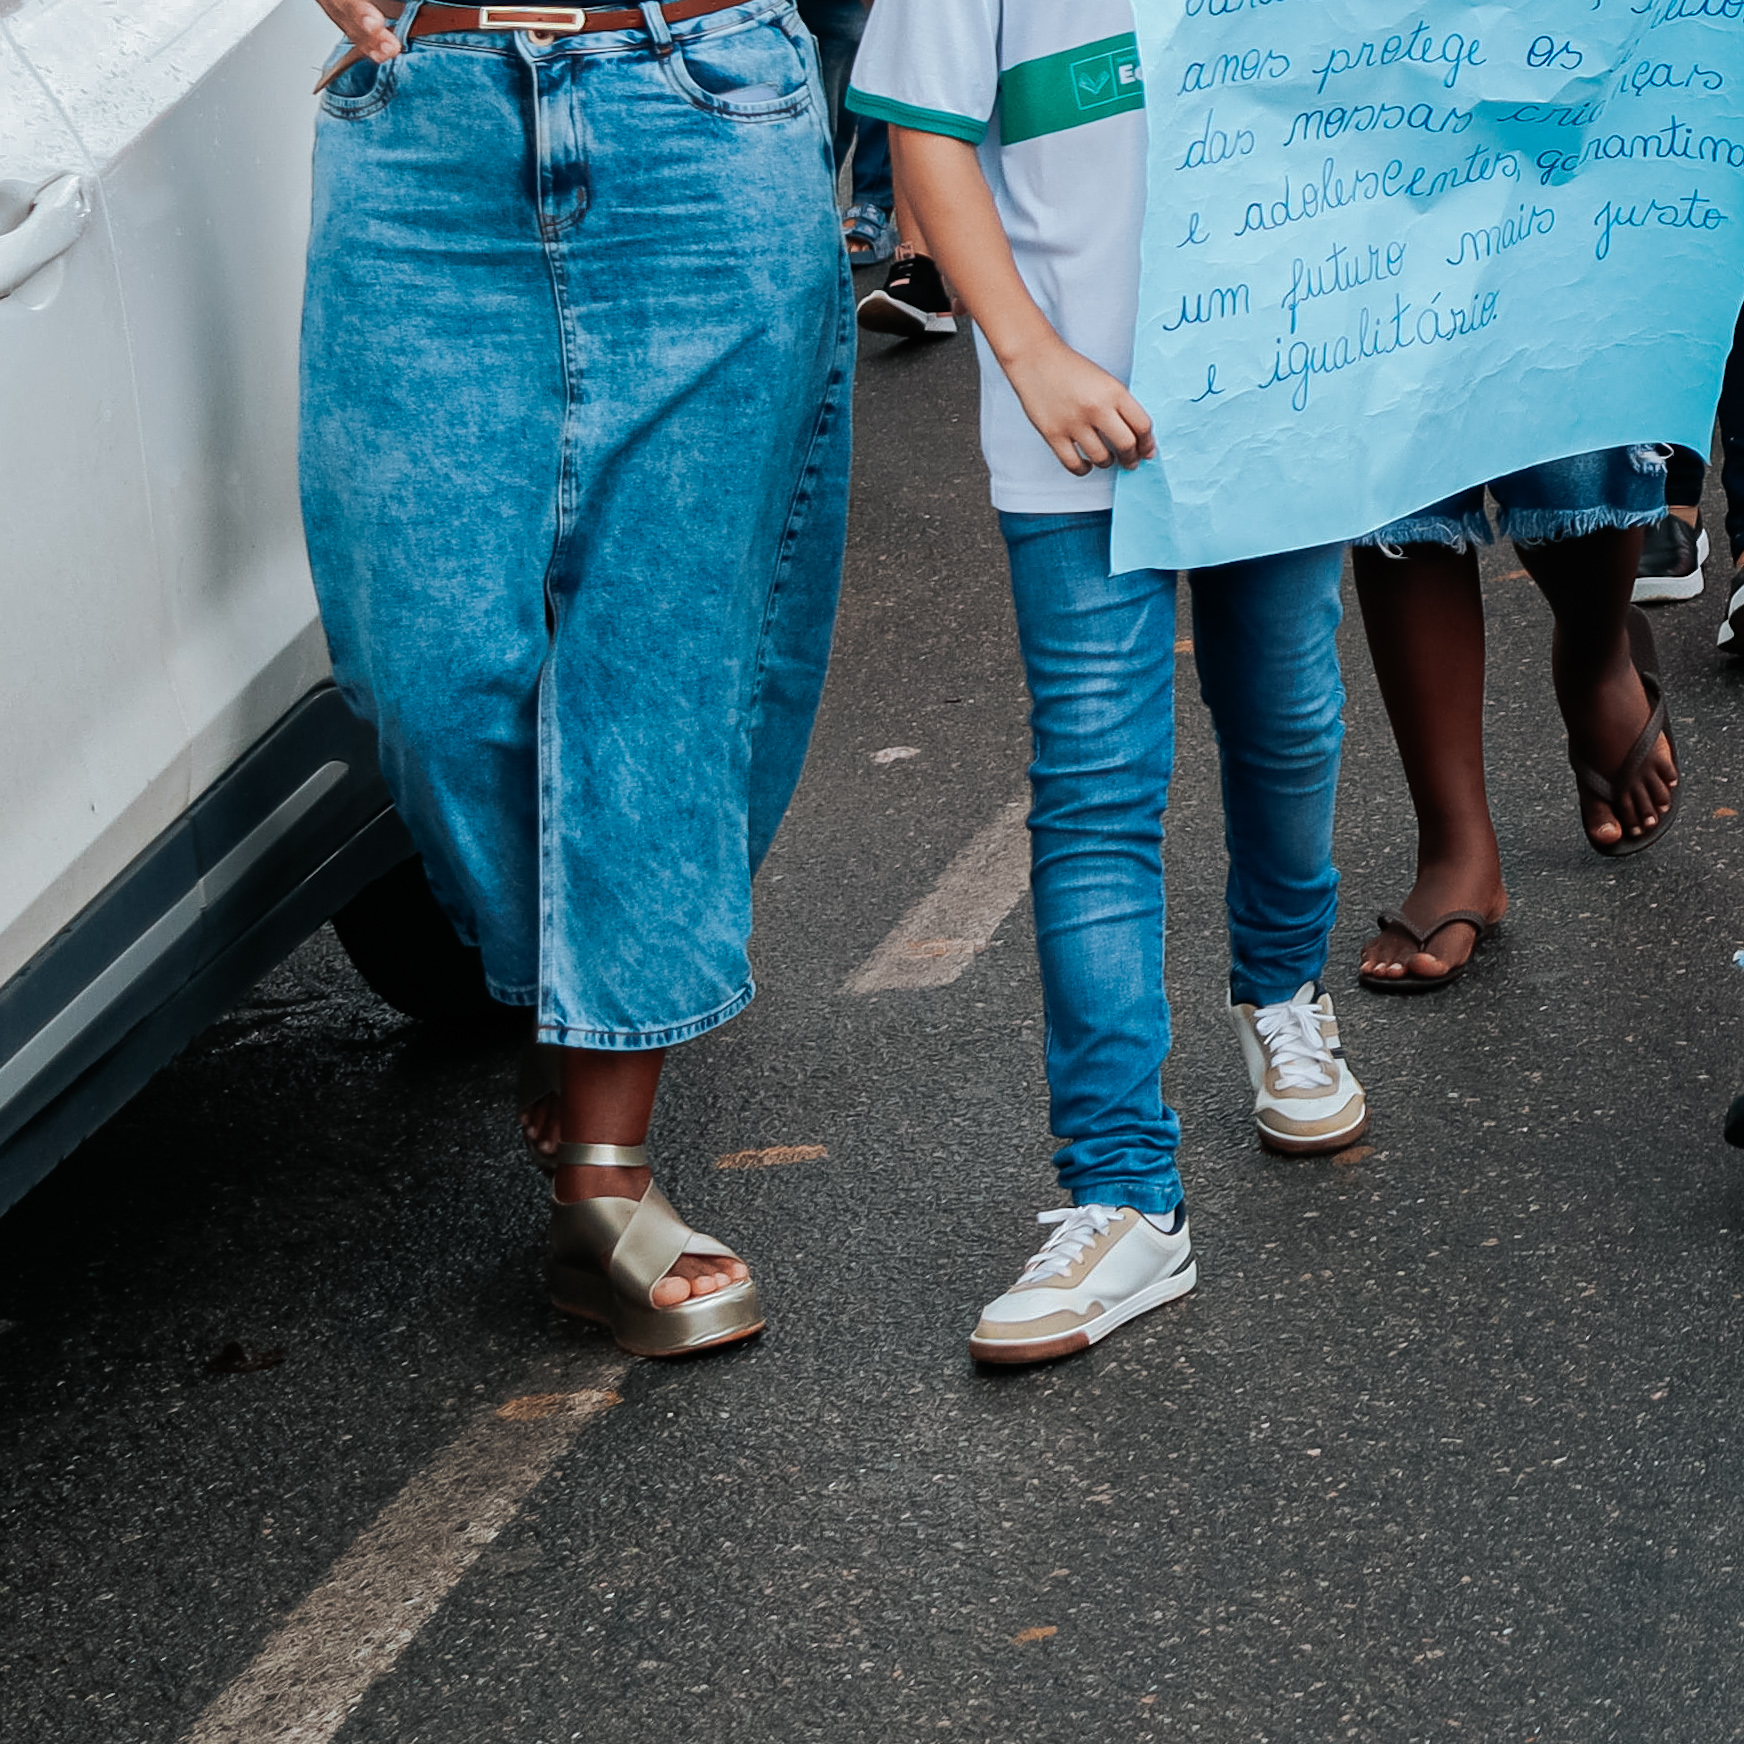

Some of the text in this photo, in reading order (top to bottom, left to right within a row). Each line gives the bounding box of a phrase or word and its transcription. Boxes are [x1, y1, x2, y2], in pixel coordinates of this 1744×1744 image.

[1176, 48, 1291, 96] anos
[1311, 19, 1488, 96] protege
[1175, 107, 1255, 170] das
[1284, 101, 1473, 146] nossas
[1176, 212, 1210, 249] e
[1234, 142, 1522, 236] adolescentes,
[1162, 188, 1729, 335] um futuro mais justo
[1189, 290, 1500, 412] e igualitário.
